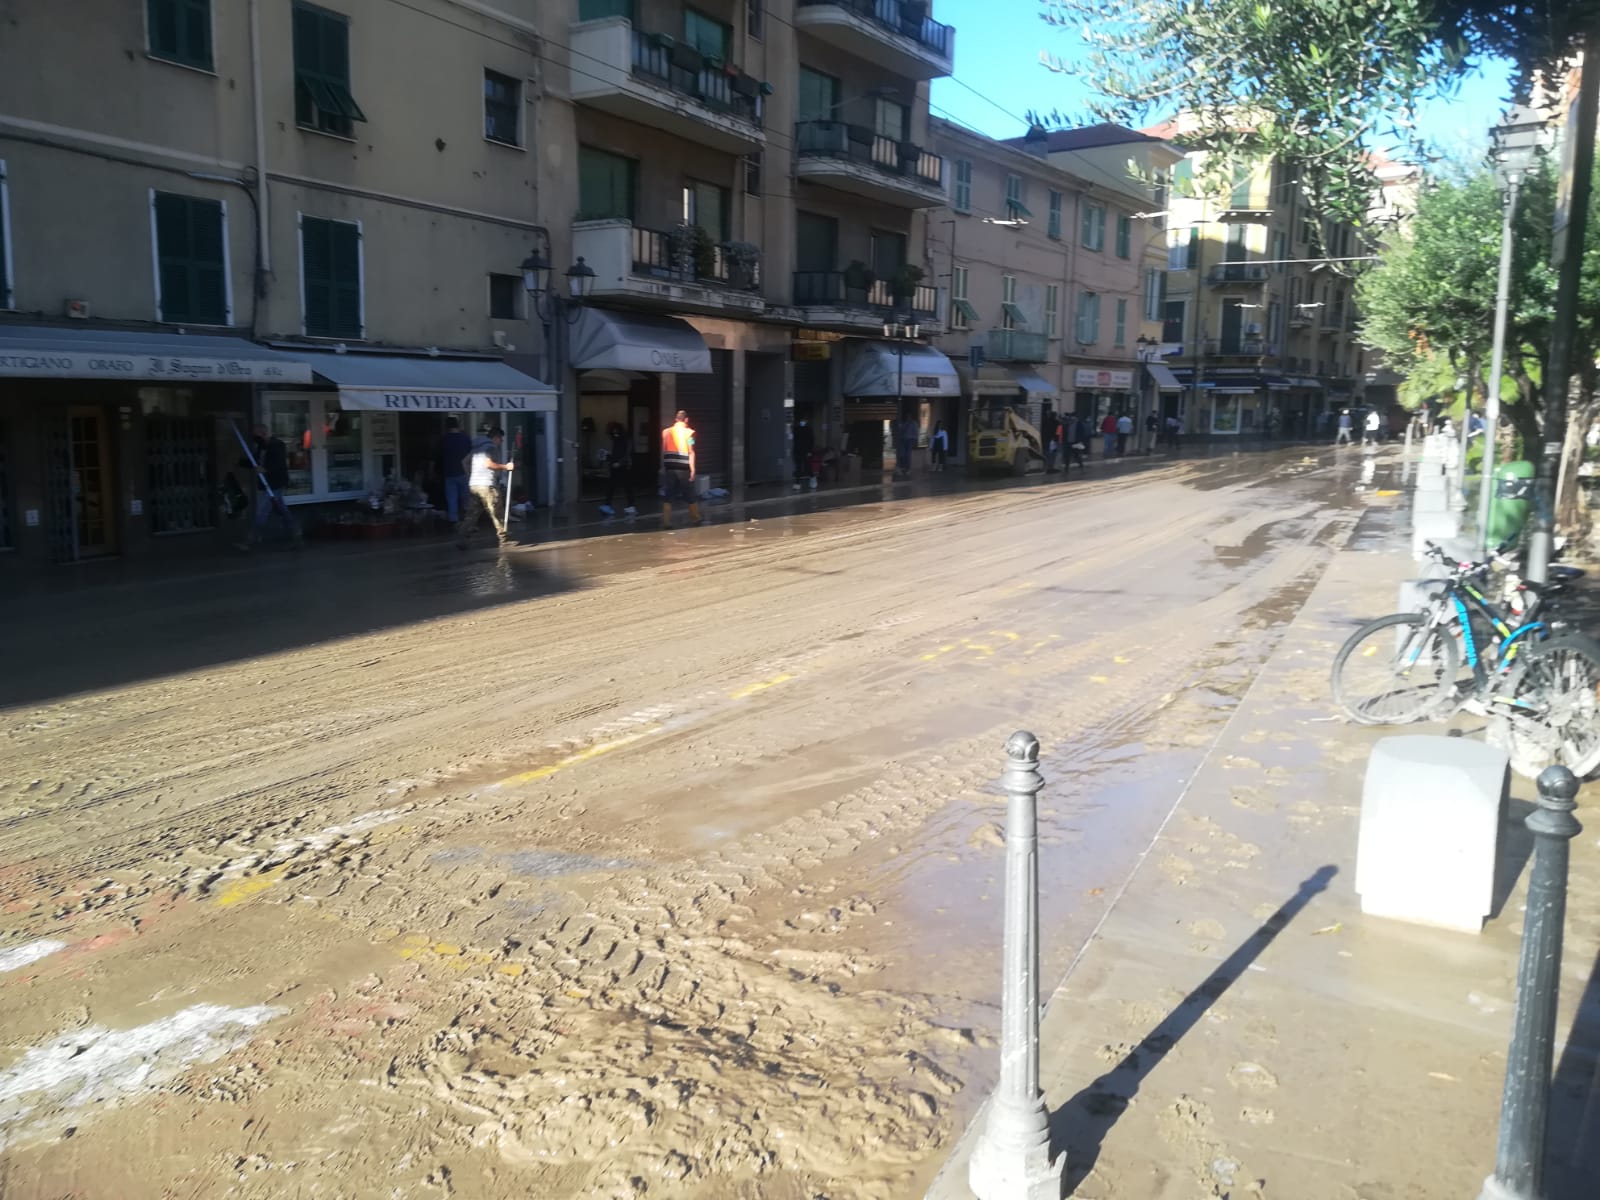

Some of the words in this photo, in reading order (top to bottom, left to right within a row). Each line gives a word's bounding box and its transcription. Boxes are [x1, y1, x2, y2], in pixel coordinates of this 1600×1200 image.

[88, 359, 134, 371] ORAFO
[384, 394, 476, 409] RIVIERA
[484, 397, 527, 409] VINI
